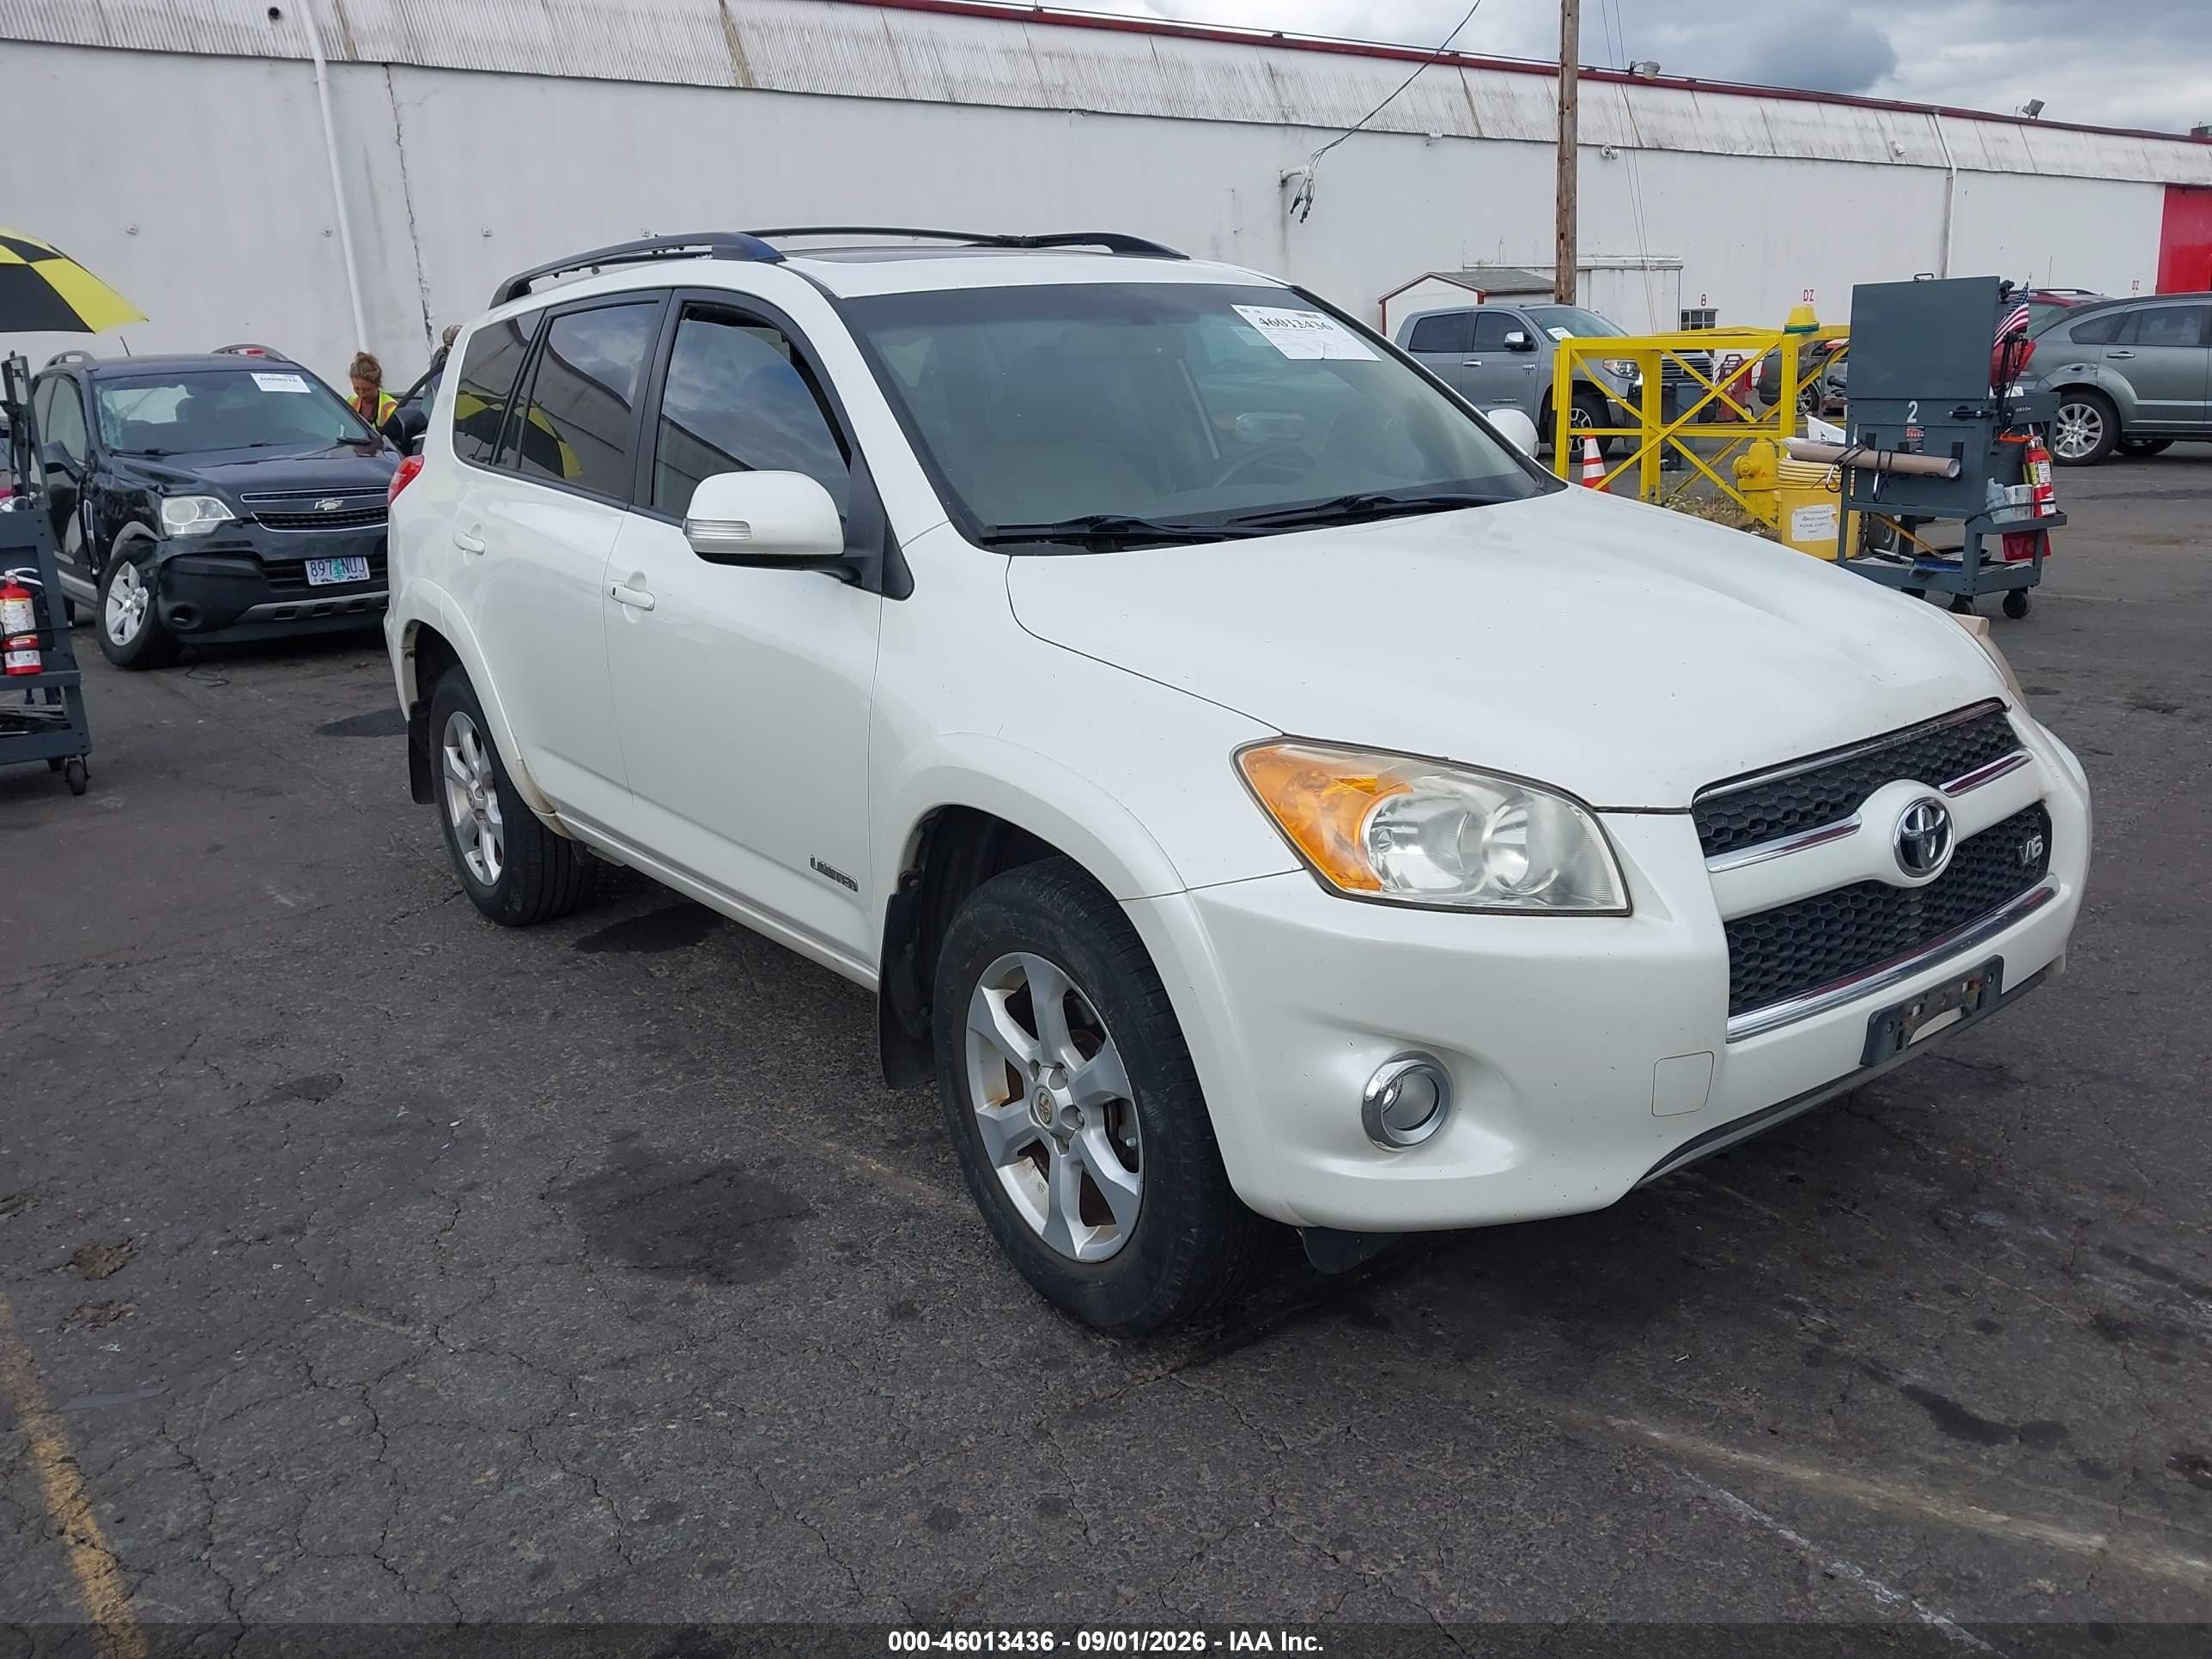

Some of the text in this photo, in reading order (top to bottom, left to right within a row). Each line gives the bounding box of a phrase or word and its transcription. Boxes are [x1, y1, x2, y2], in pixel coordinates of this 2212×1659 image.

[1700, 294, 1707, 307] 8
[1802, 289, 1814, 302] DZ
[1258, 317, 1334, 331] 46013436
[1906, 400, 1918, 423] 2
[310, 560, 333, 578] 897
[2014, 834, 2044, 866] V6
